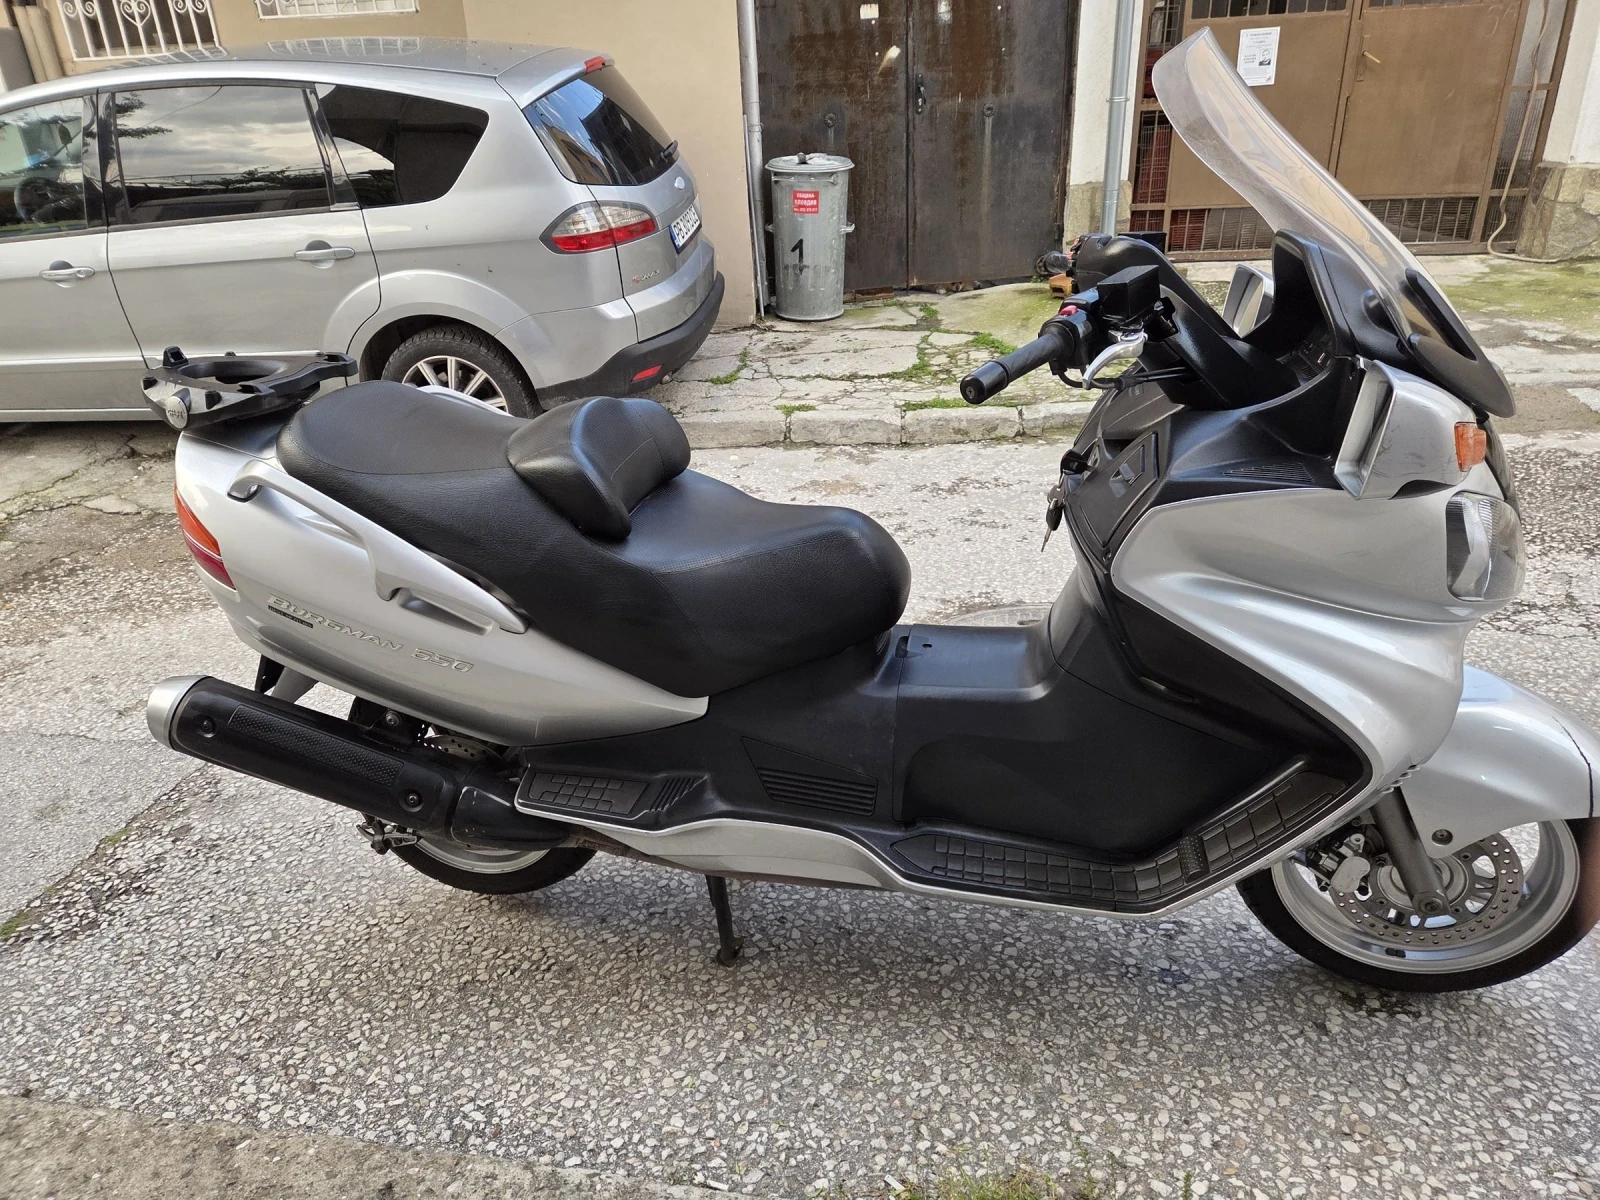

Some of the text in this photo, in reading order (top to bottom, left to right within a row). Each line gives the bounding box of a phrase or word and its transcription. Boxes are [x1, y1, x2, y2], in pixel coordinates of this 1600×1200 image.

[790, 238, 804, 275] 1
[267, 593, 404, 652] BURGMAN
[411, 648, 474, 673] 650
